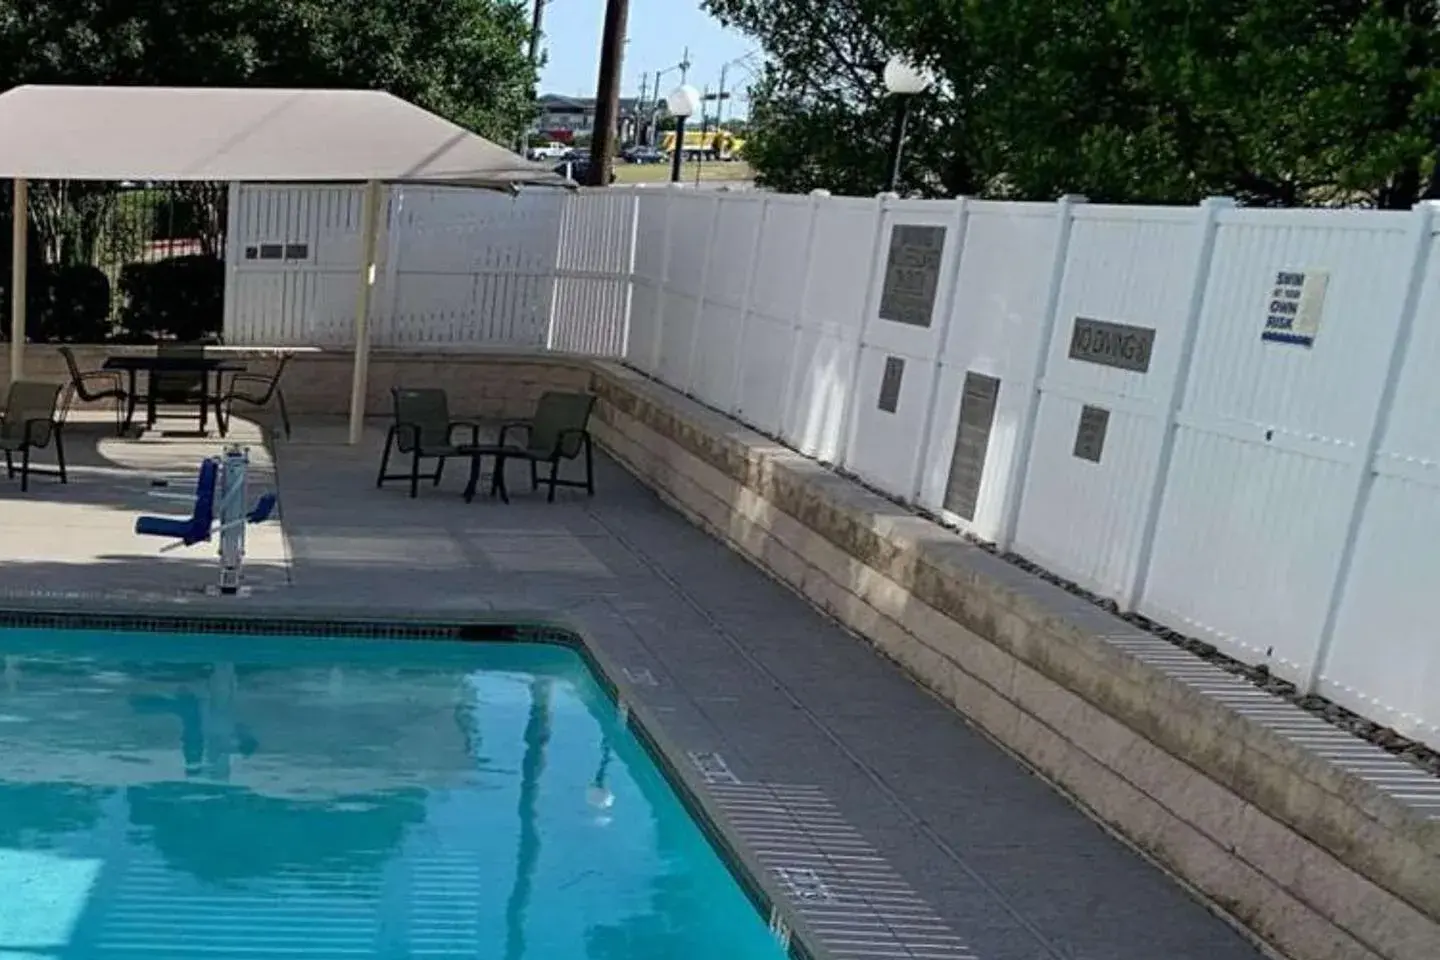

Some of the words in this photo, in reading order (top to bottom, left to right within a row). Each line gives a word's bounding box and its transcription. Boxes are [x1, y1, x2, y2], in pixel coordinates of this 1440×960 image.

[1276, 272, 1305, 286] SWIM
[1269, 300, 1299, 314] OWN
[1265, 315, 1295, 330] RISK
